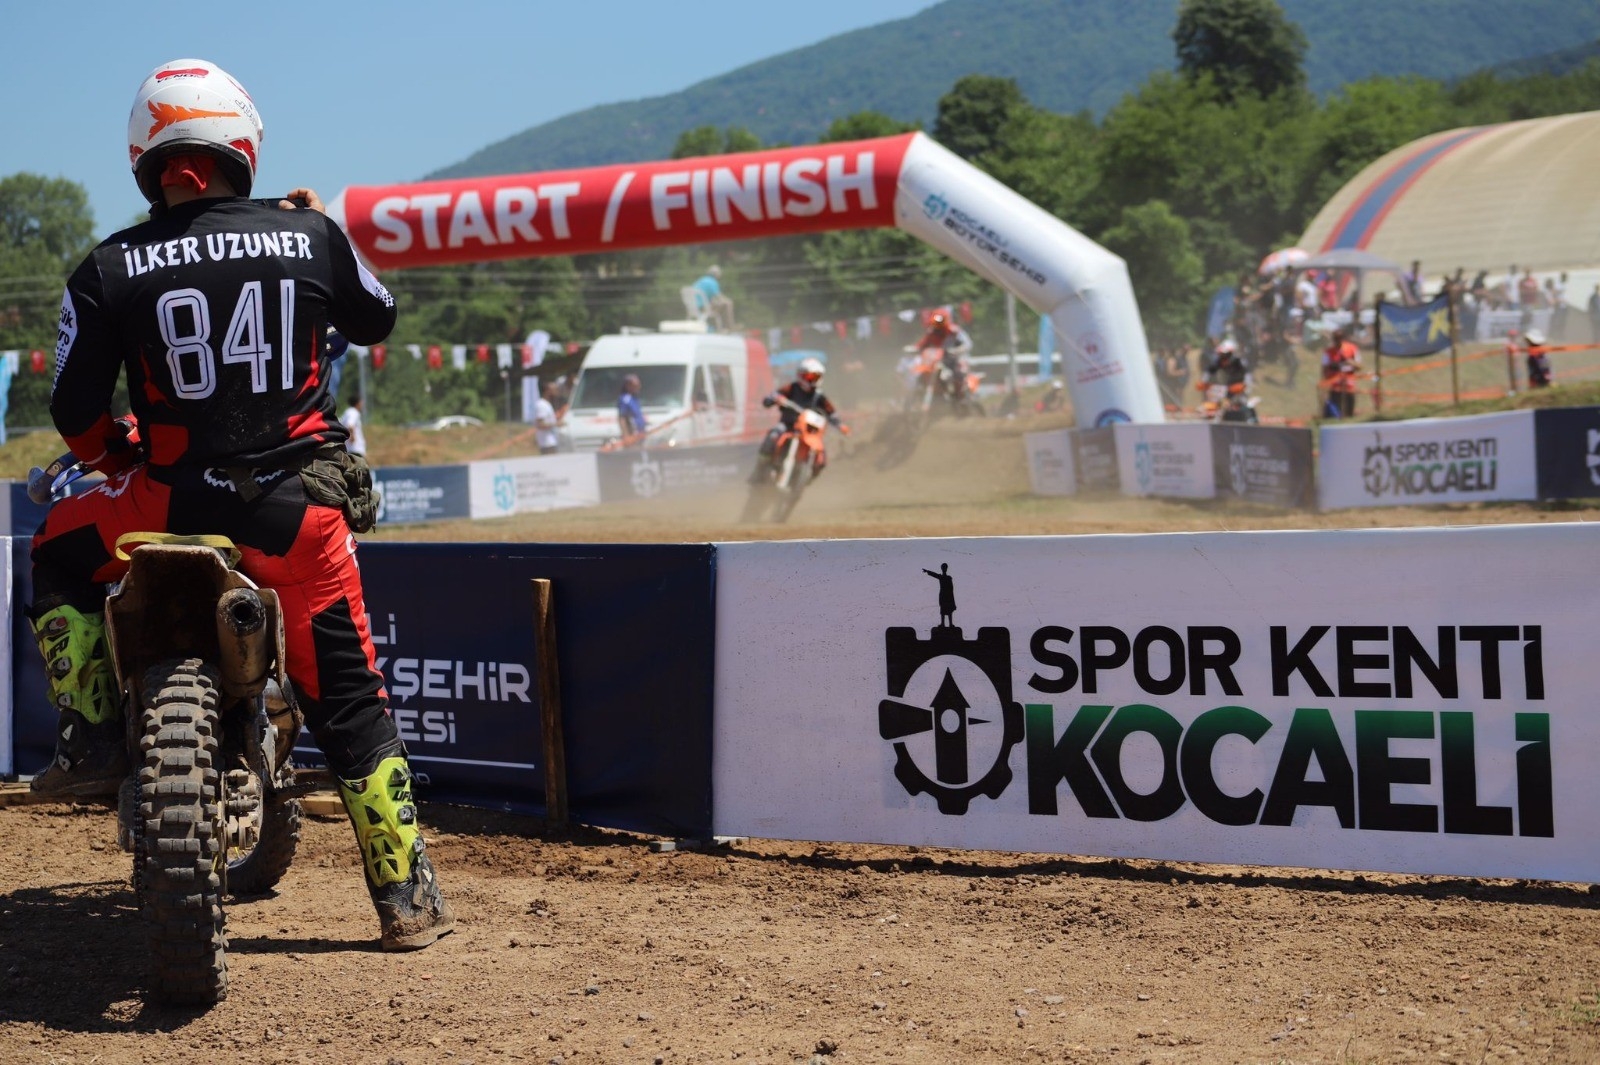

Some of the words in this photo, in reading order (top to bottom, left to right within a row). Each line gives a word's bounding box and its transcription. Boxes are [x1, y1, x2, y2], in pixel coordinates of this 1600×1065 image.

[370, 181, 581, 254] START
[601, 171, 636, 243] /
[650, 151, 878, 231] FINISH
[121, 236, 203, 279] İLKER
[206, 231, 314, 262] UZUNER
[156, 278, 295, 400] 841
[1394, 442, 1440, 463] SPOR
[1026, 624, 1244, 696] SPOR
